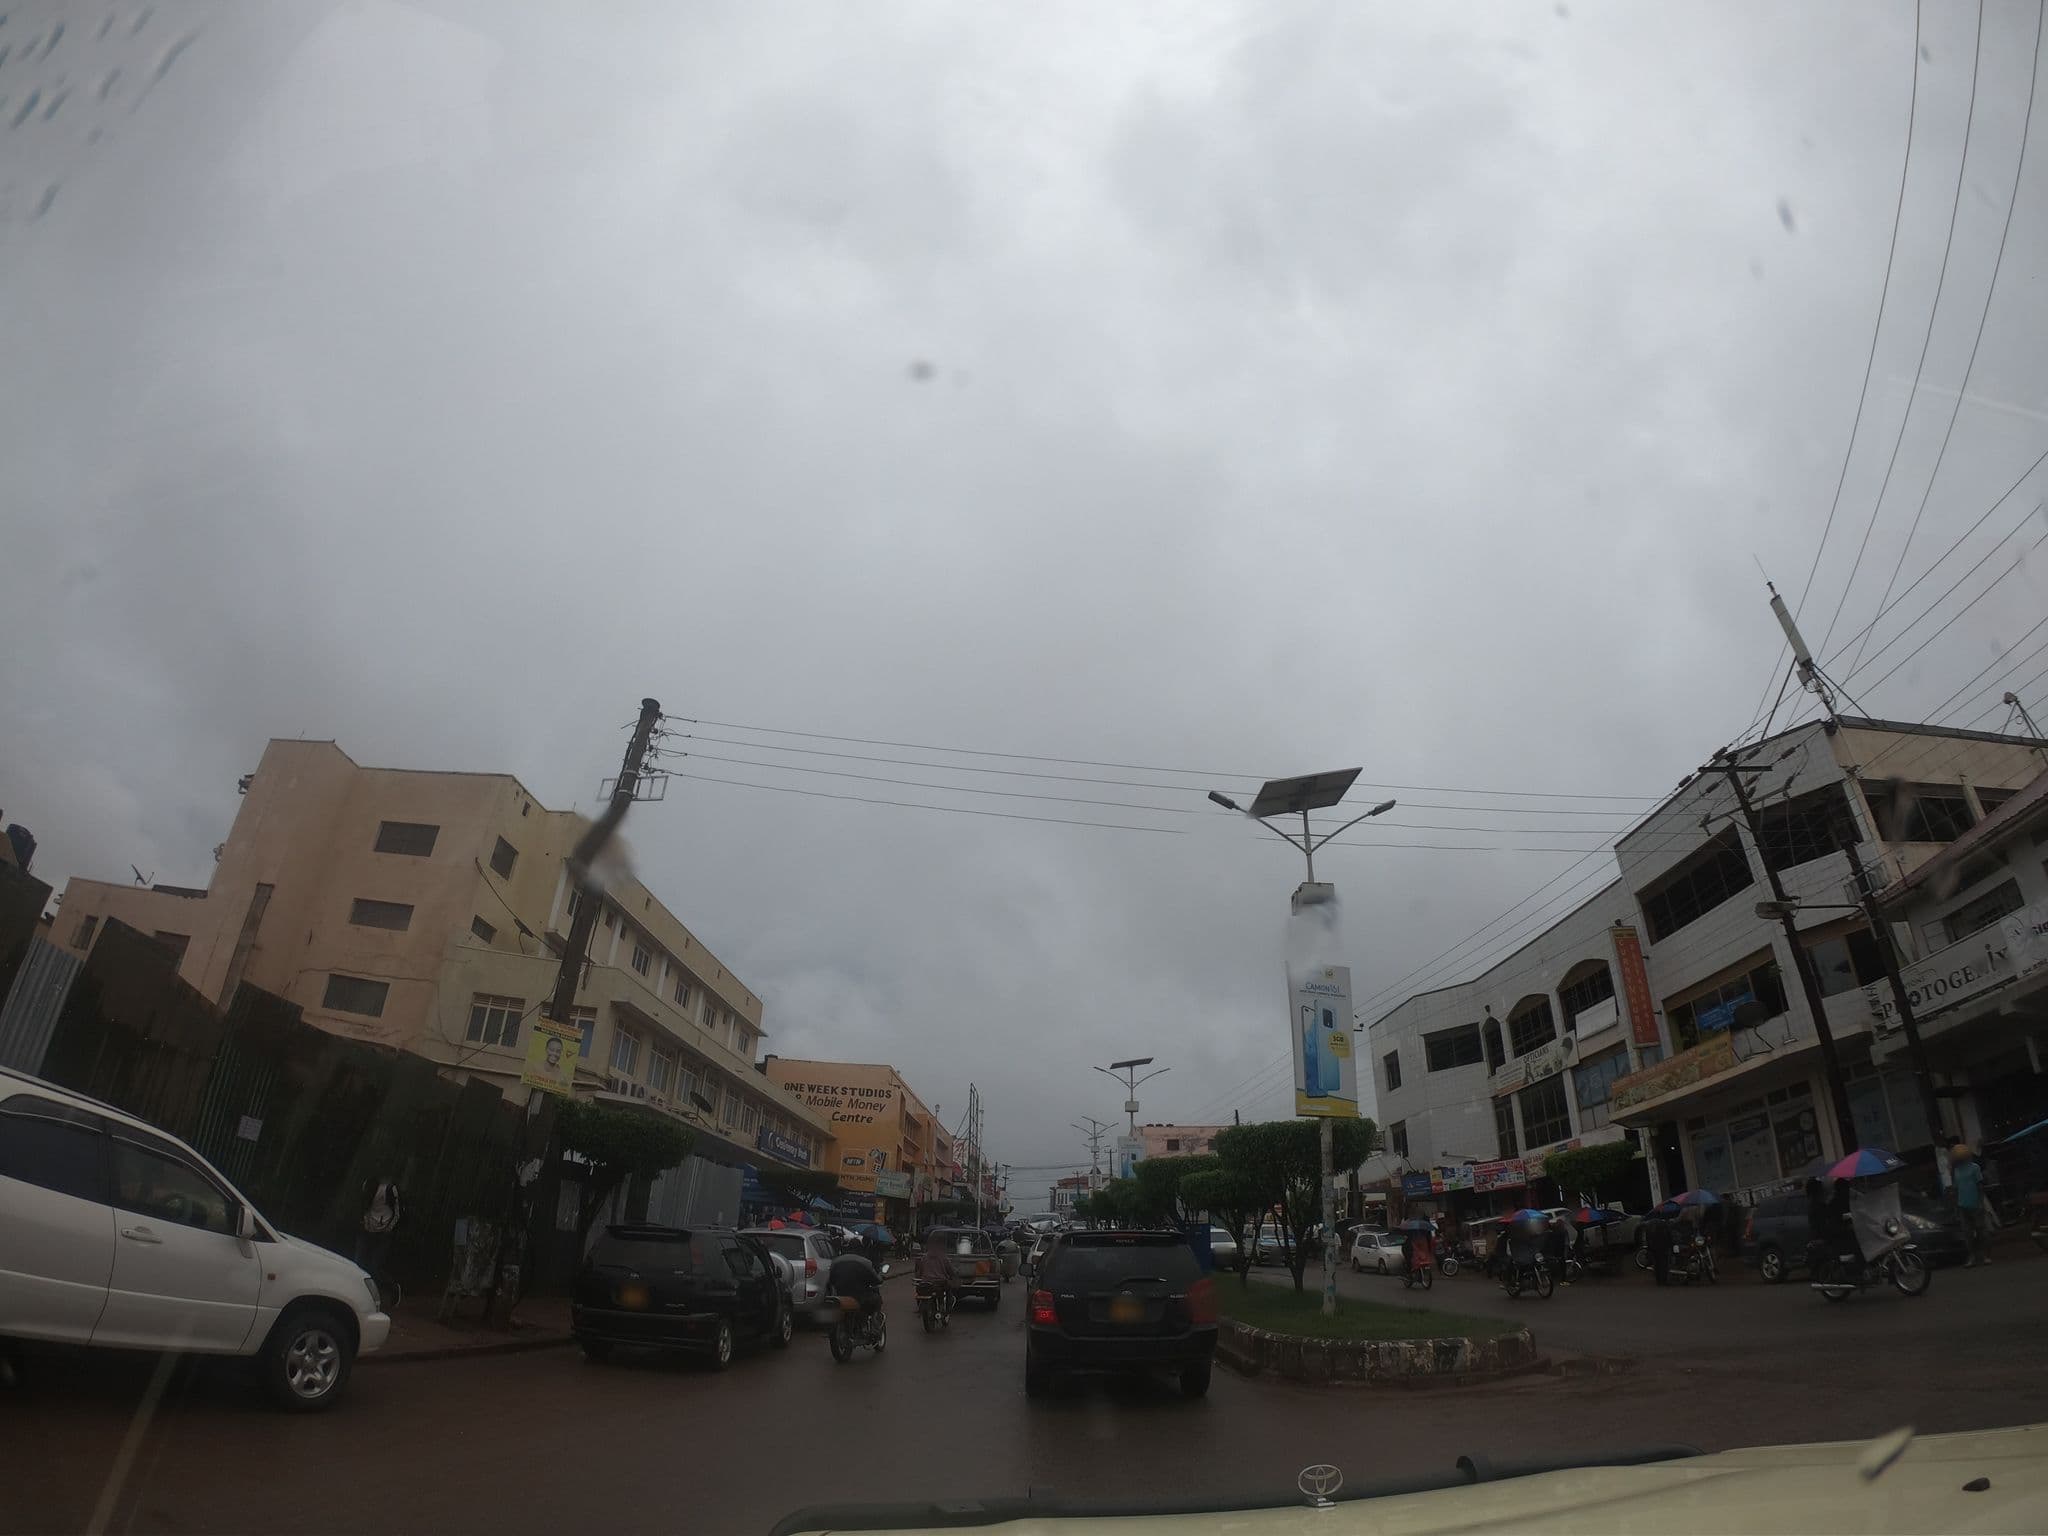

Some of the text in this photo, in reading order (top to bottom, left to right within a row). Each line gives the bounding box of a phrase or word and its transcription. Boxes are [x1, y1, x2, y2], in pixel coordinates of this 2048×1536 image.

[784, 1082, 892, 1099] ONE WEEK STUDIOS
[806, 1095, 843, 1108] Mobile
[847, 1099, 886, 1112] Money
[832, 1111, 874, 1124] Centre
[846, 1158, 862, 1166] MTN
